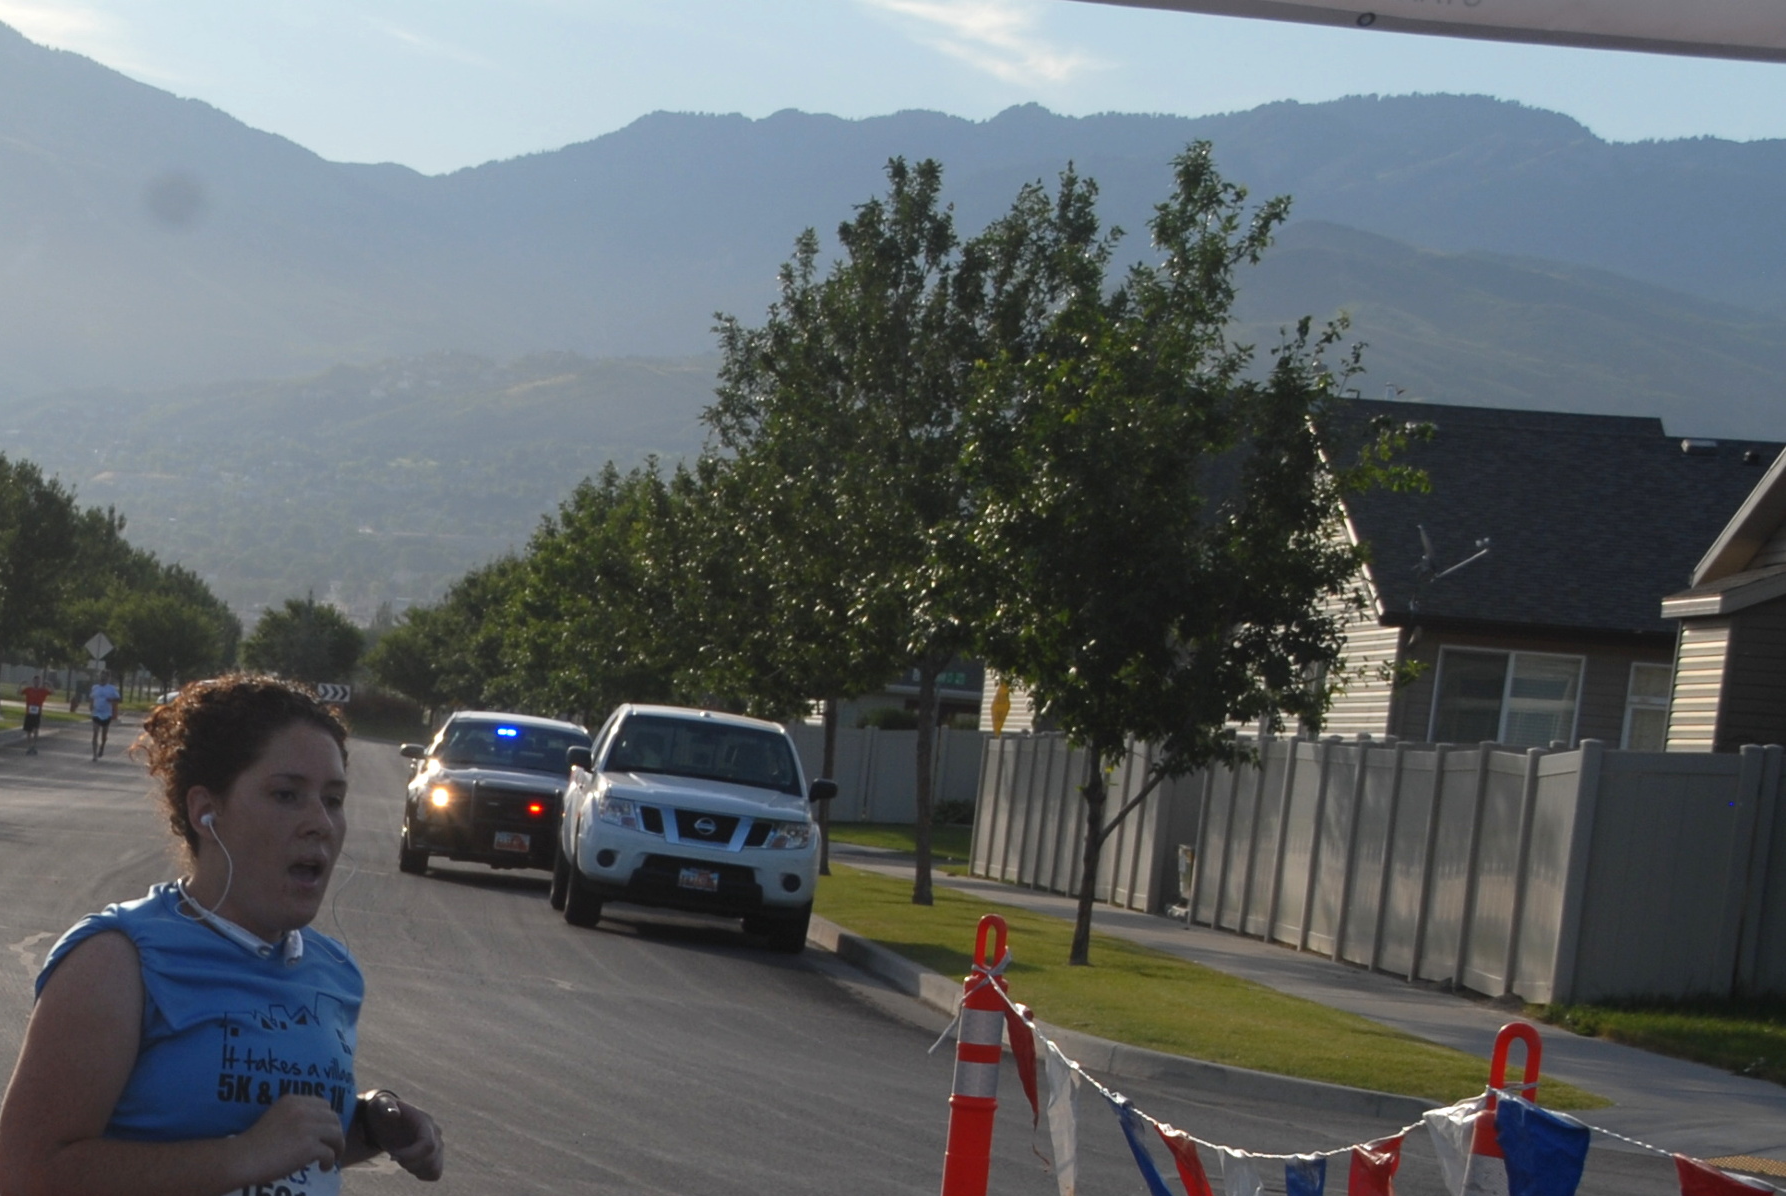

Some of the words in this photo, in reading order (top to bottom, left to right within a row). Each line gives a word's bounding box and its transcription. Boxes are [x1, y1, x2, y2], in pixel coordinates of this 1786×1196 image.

[222, 1043, 240, 1070] It
[243, 1047, 302, 1076] takes
[307, 1063, 320, 1078] a
[217, 1072, 252, 1103] 5K
[256, 1081, 273, 1105] &
